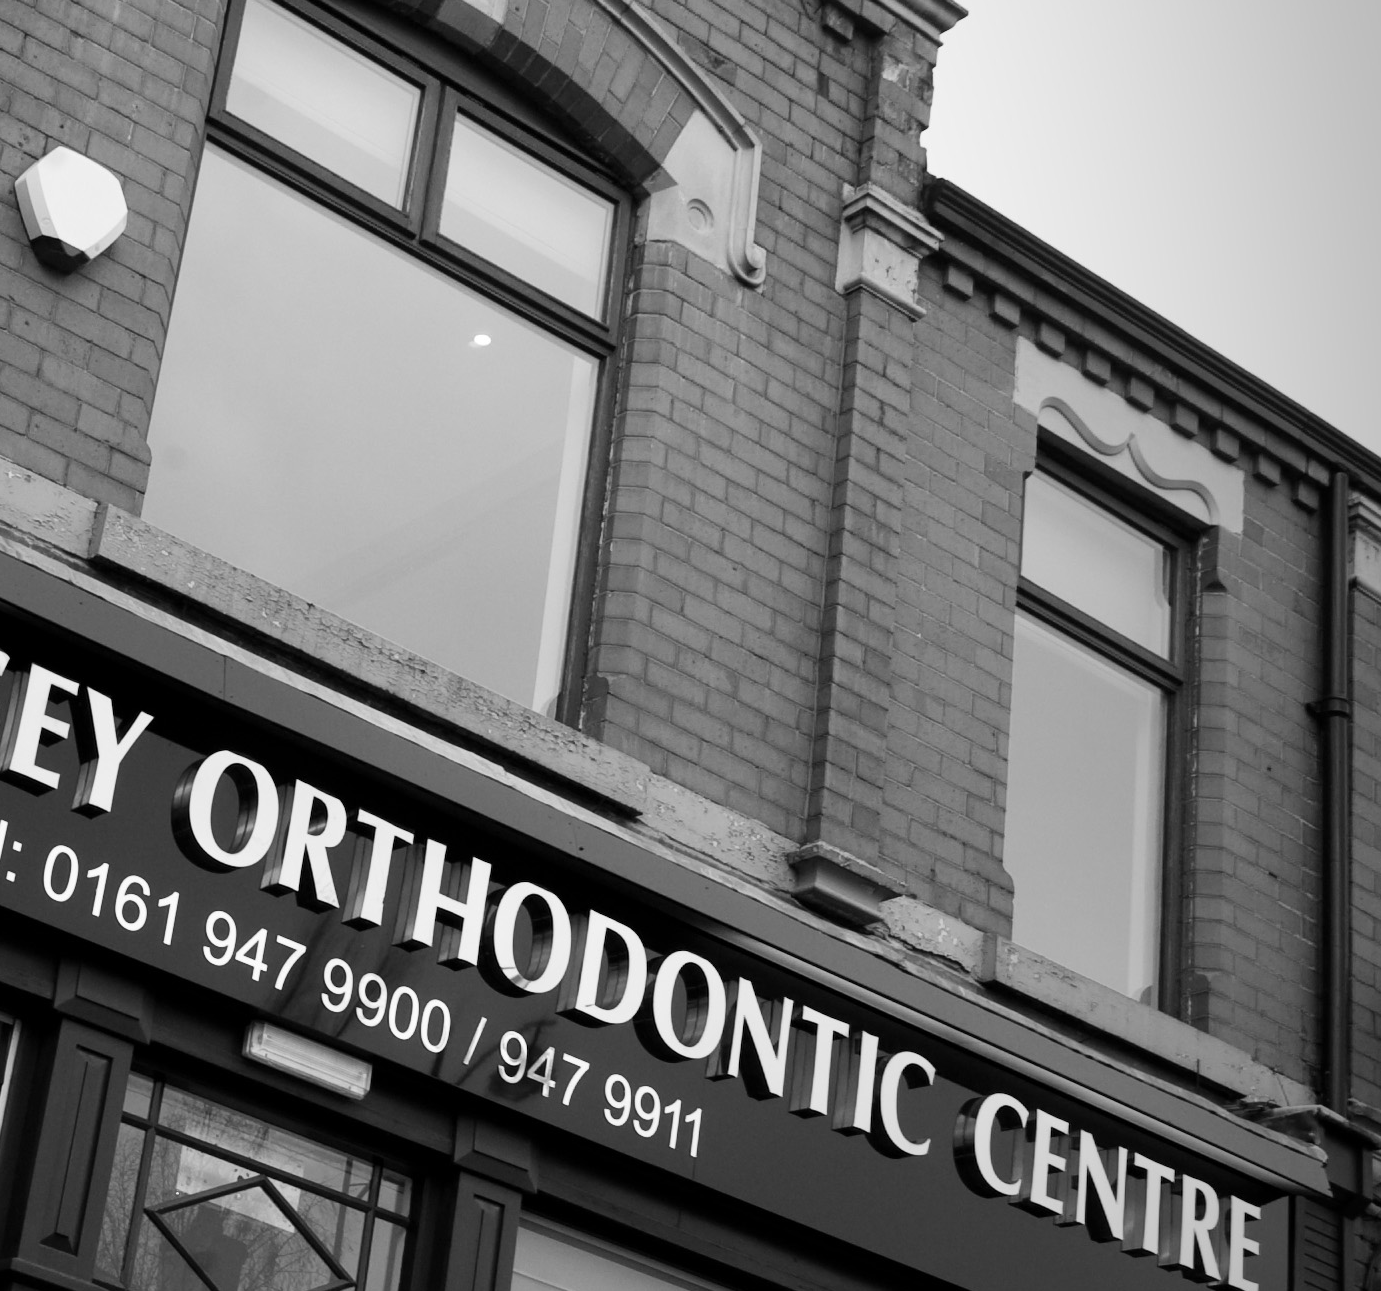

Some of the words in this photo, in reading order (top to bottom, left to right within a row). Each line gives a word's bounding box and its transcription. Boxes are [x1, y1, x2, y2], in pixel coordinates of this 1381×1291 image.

[43, 845, 180, 946] 0161
[202, 911, 307, 991] 947
[321, 958, 452, 1054] 9900
[498, 1030, 590, 1107] 947
[603, 1073, 704, 1157] 9911
[187, 749, 937, 1156] ORTHODONTIC
